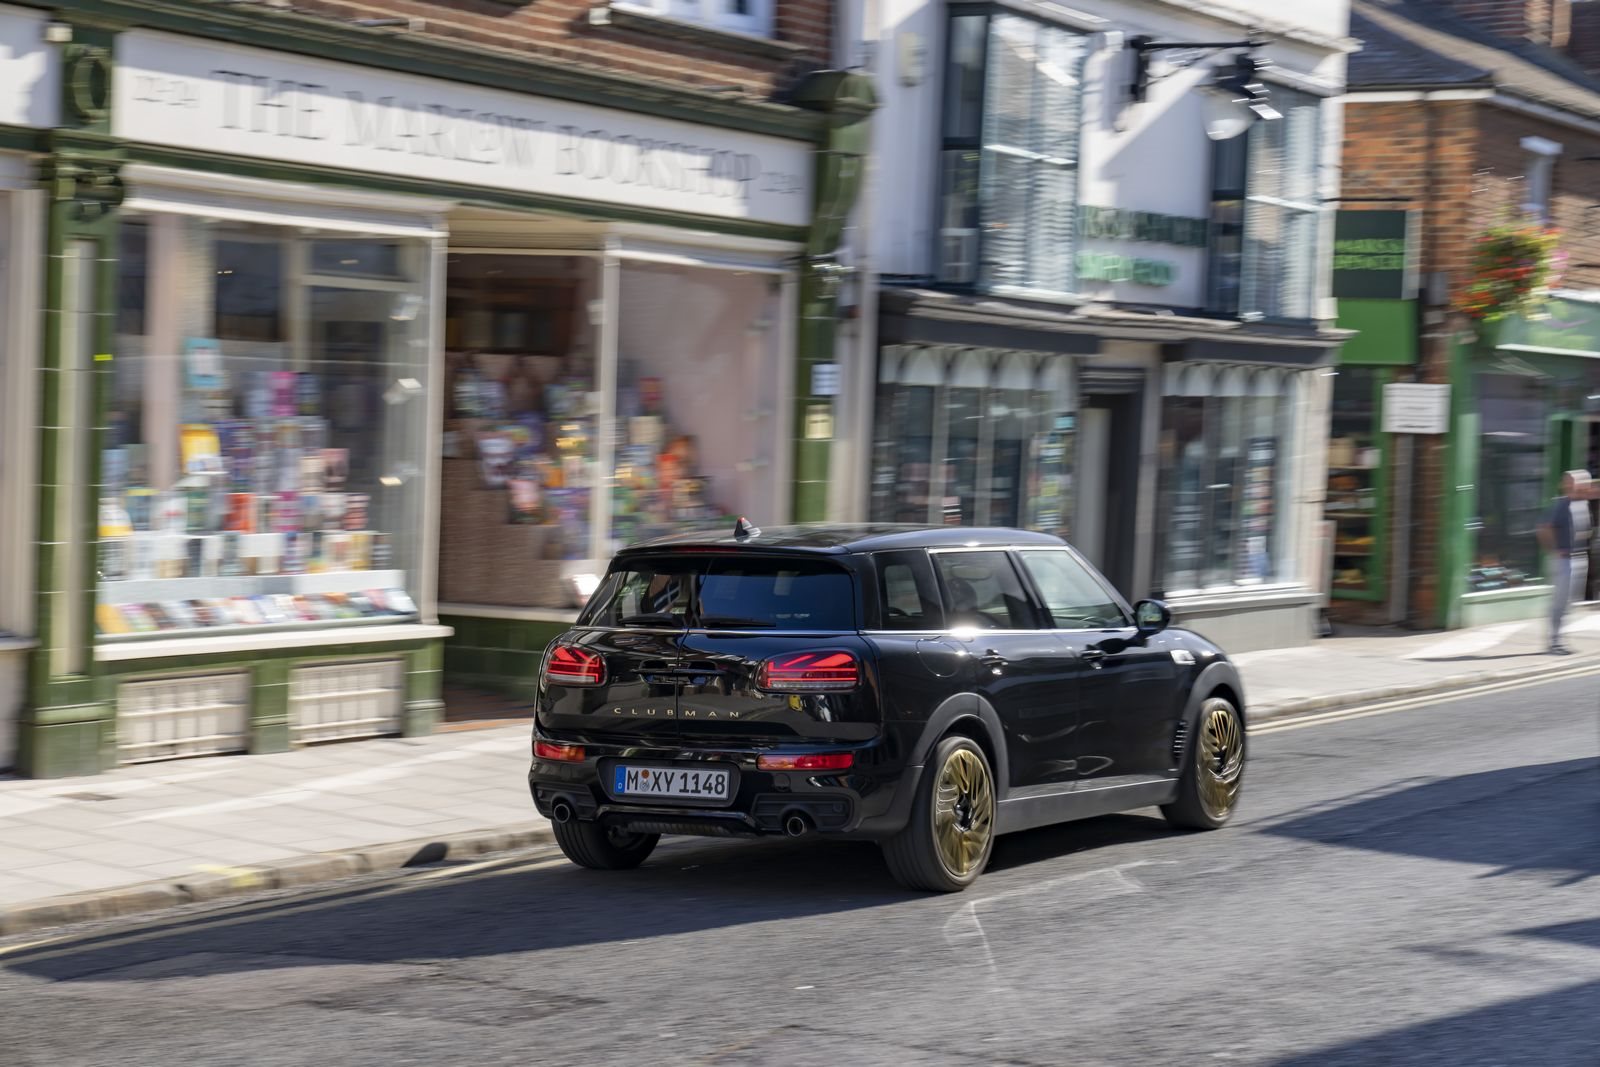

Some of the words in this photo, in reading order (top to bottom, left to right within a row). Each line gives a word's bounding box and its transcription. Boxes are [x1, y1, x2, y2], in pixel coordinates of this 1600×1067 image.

[211, 70, 326, 140] THE
[342, 90, 547, 169] MARLOW
[614, 707, 740, 719] CLUBMAN
[626, 769, 639, 791] M
[650, 771, 675, 793] XY
[678, 772, 726, 795] 1148
